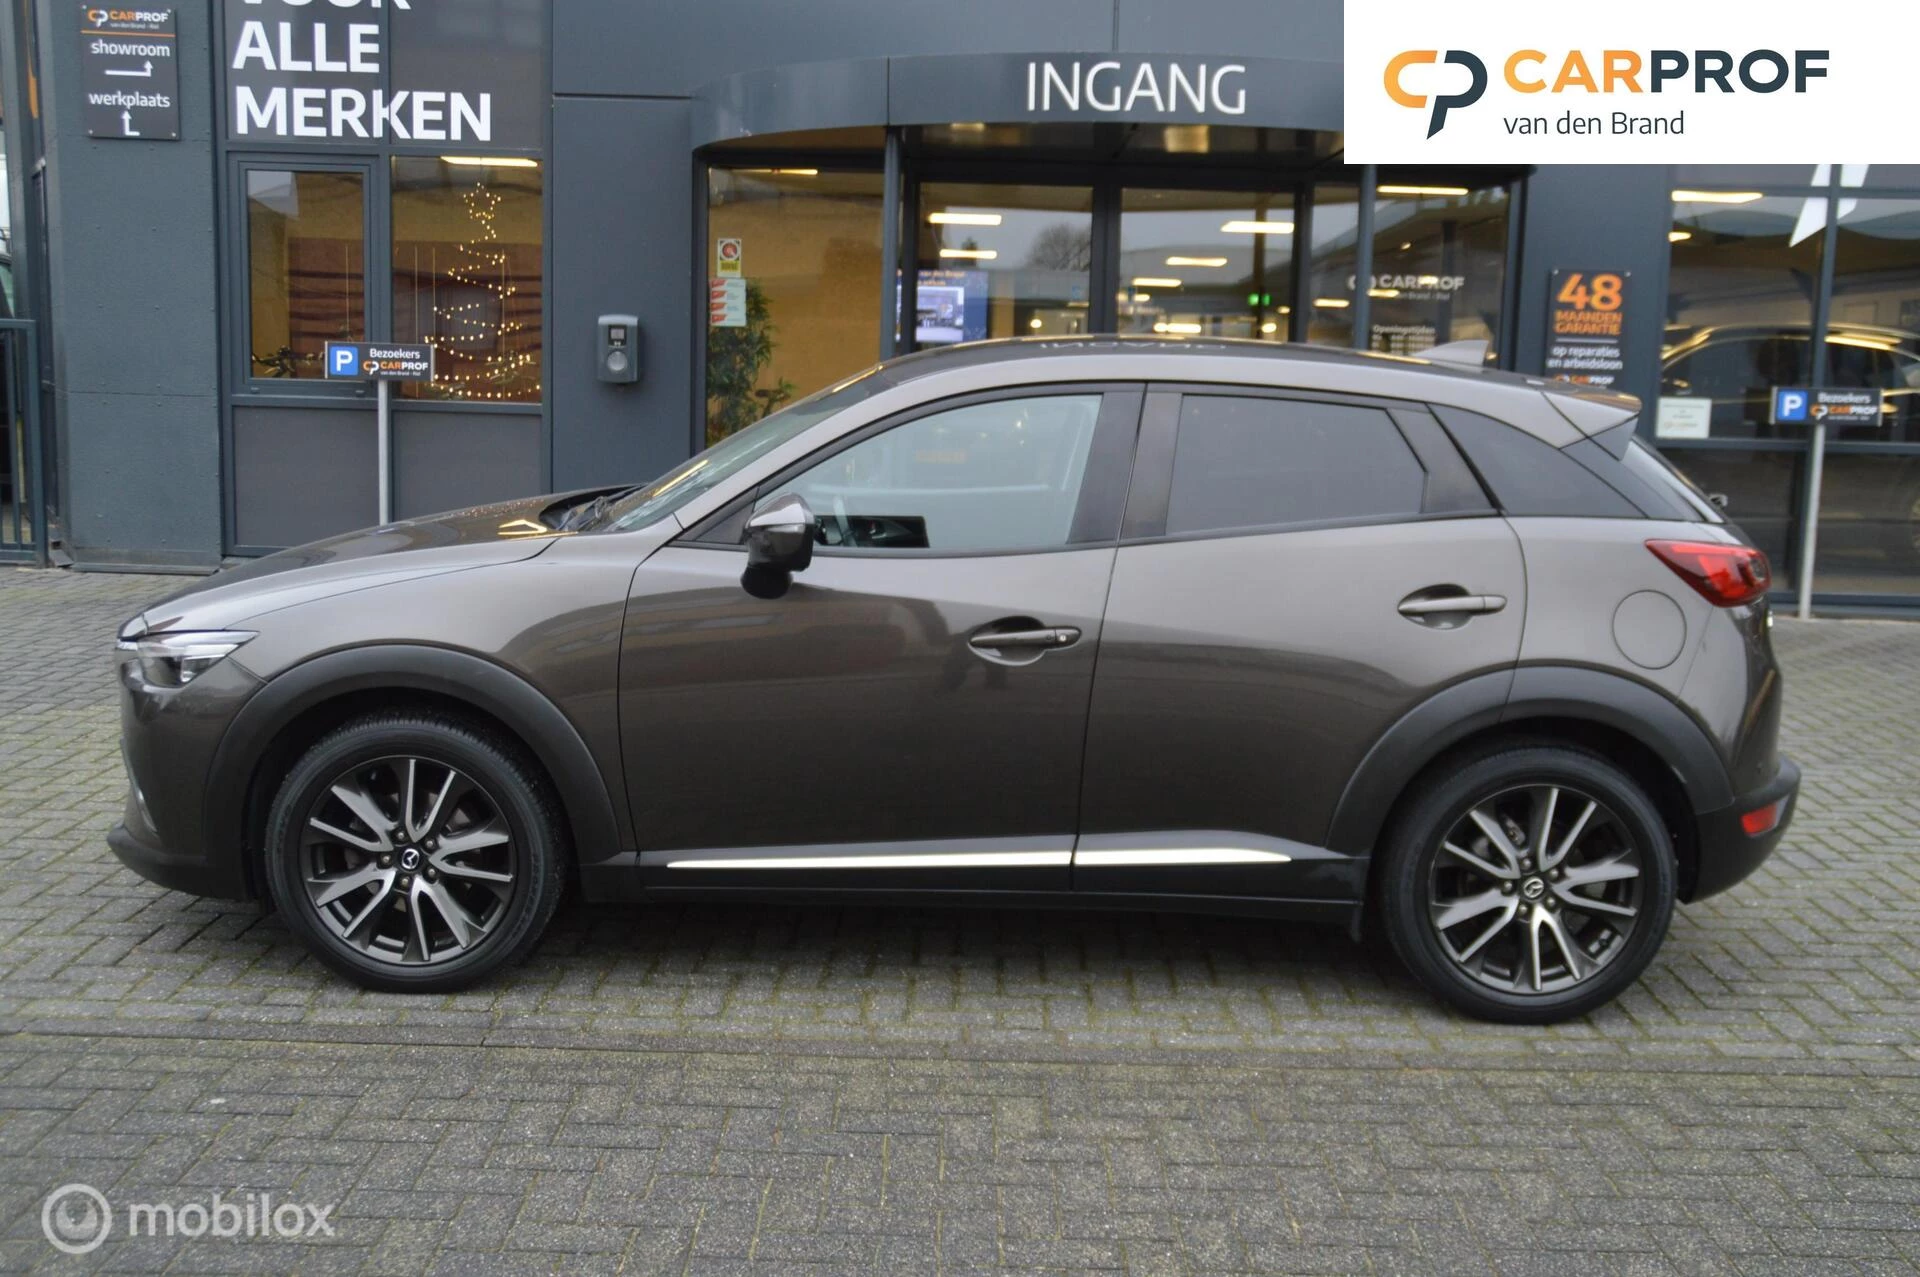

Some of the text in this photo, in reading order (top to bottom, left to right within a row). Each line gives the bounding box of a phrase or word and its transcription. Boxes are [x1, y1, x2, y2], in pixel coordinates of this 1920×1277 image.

[109, 10, 169, 22] CARPROF
[91, 39, 171, 57] showroom
[232, 20, 380, 73] ALLE
[1028, 61, 1246, 114] INGANG
[88, 90, 171, 109] werkplaats
[235, 86, 491, 141] MERKEN
[1556, 273, 1623, 312] 48
[1555, 310, 1623, 323] MAANDEN
[1555, 322, 1622, 335] GARANTIE
[369, 348, 421, 359] Bezoekers
[1552, 346, 1620, 358] op reparaties
[380, 361, 429, 371] CARPROF
[1547, 358, 1624, 370] en arbeidsloon
[1818, 392, 1872, 404] Bezoekers
